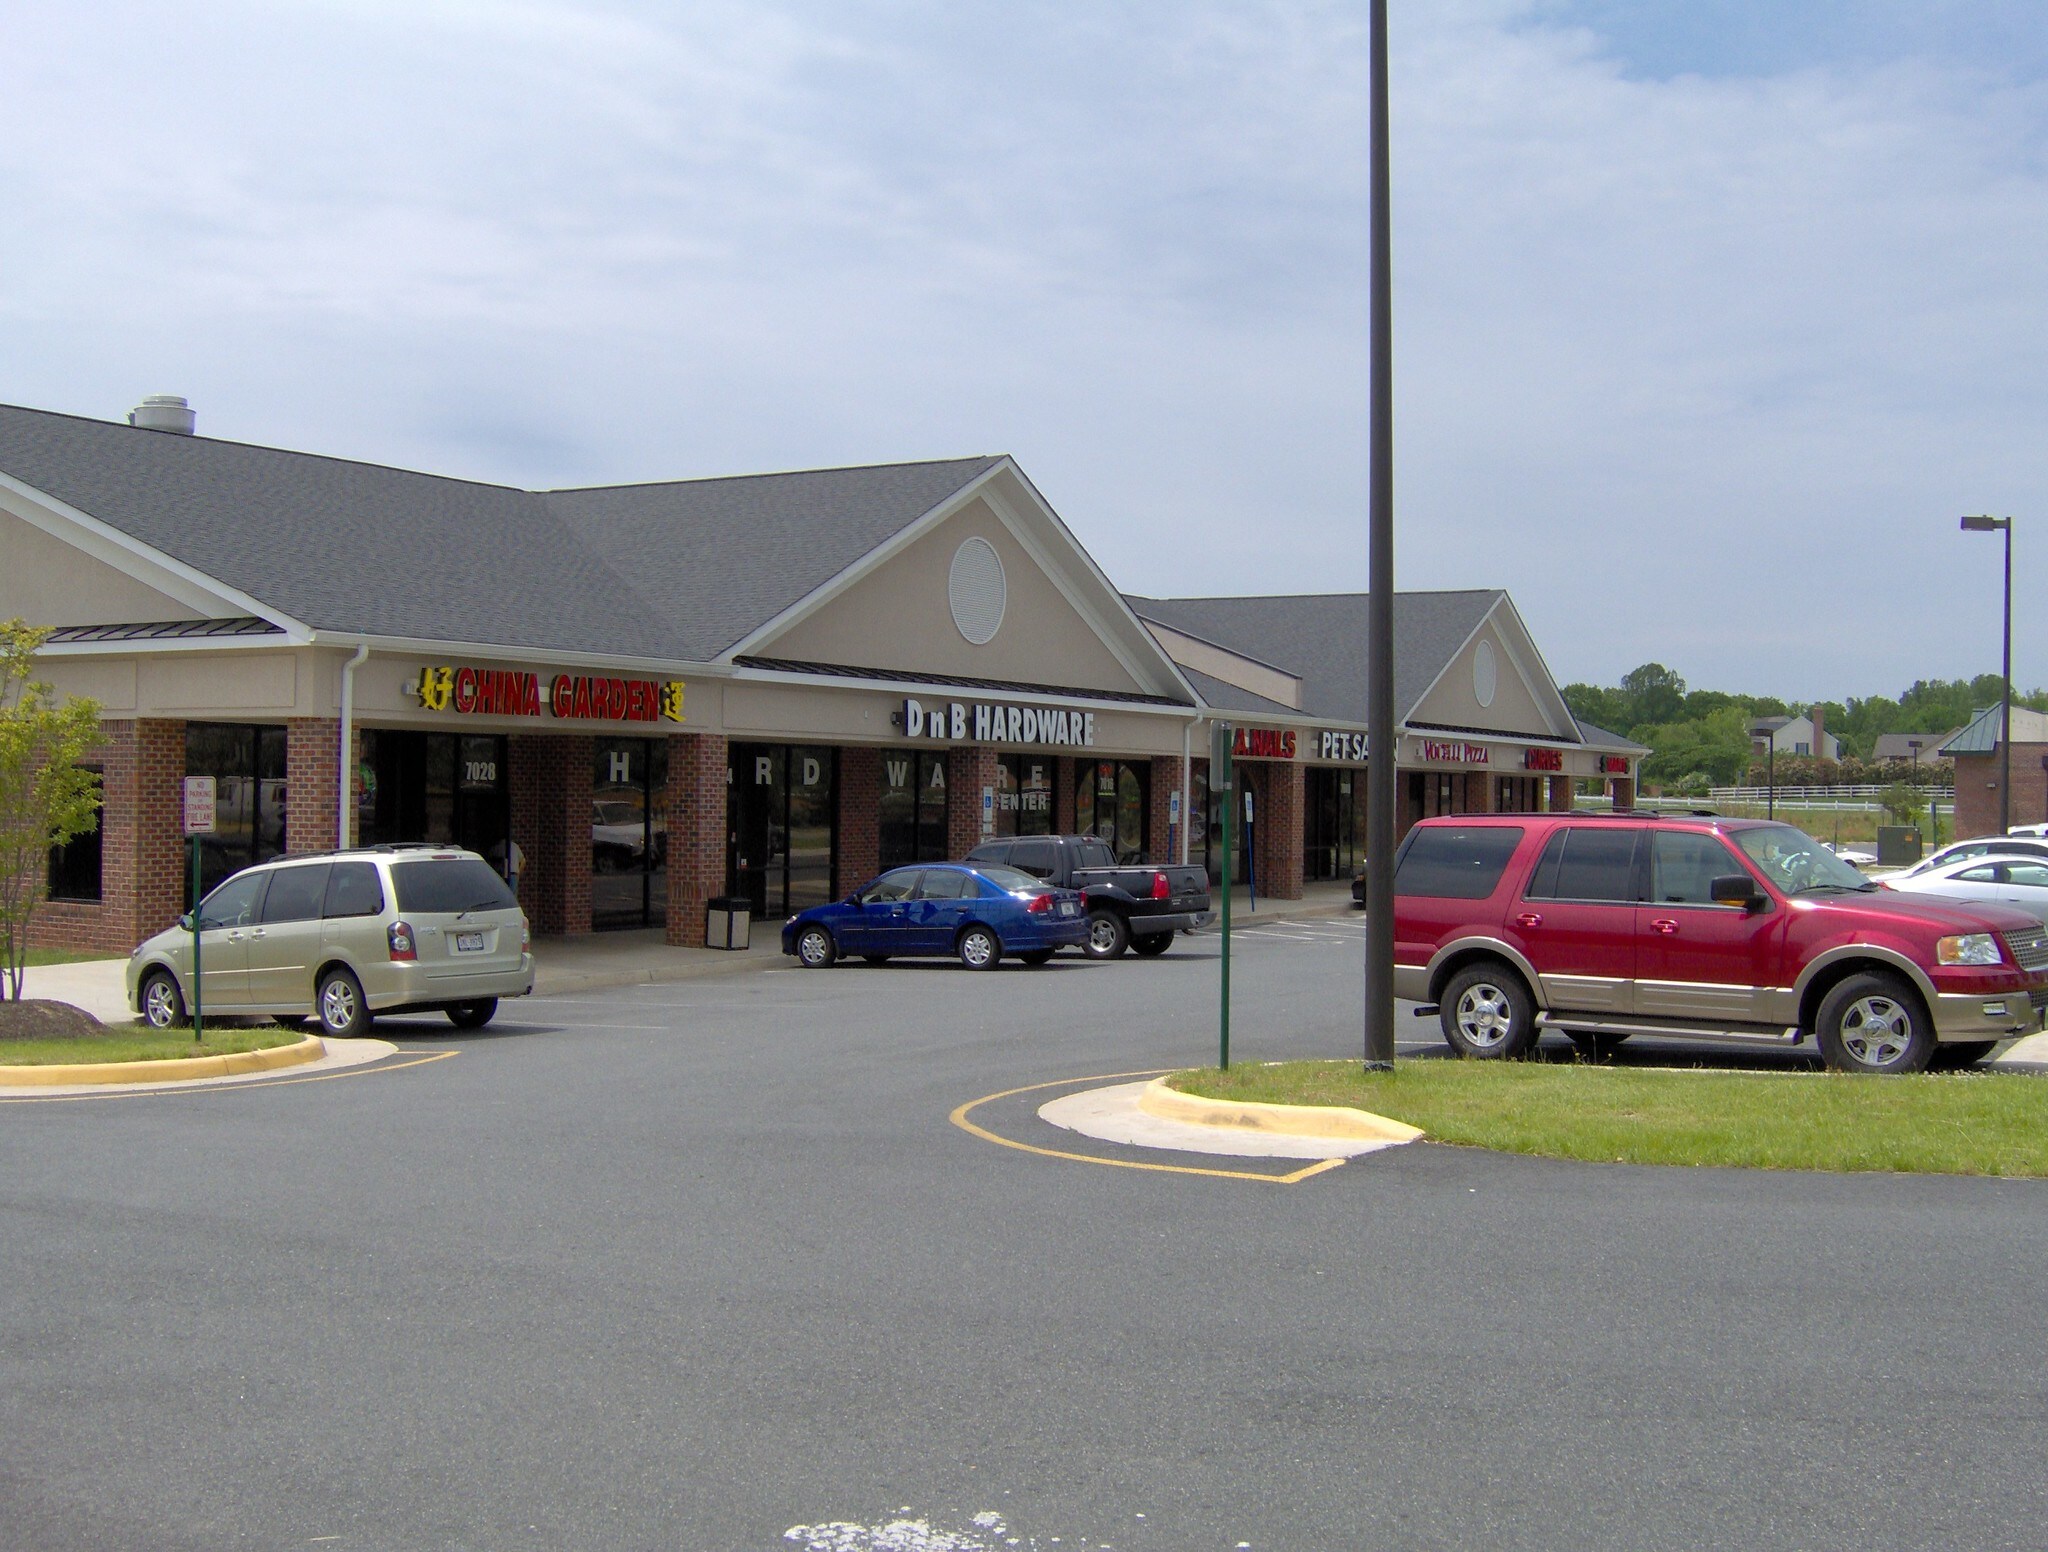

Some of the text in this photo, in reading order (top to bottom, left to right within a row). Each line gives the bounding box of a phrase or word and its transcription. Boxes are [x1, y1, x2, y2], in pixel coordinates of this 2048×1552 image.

[456, 667, 659, 722] CHINA GARDEN
[974, 704, 1095, 747] HARDWARE
[1320, 731, 1350, 760] PET
[1463, 742, 1489, 764] PIZZA
[465, 761, 497, 782] 7028
[189, 790, 212, 798] PARKING
[996, 793, 1047, 811] ENTER
[187, 803, 213, 811] STANDING
